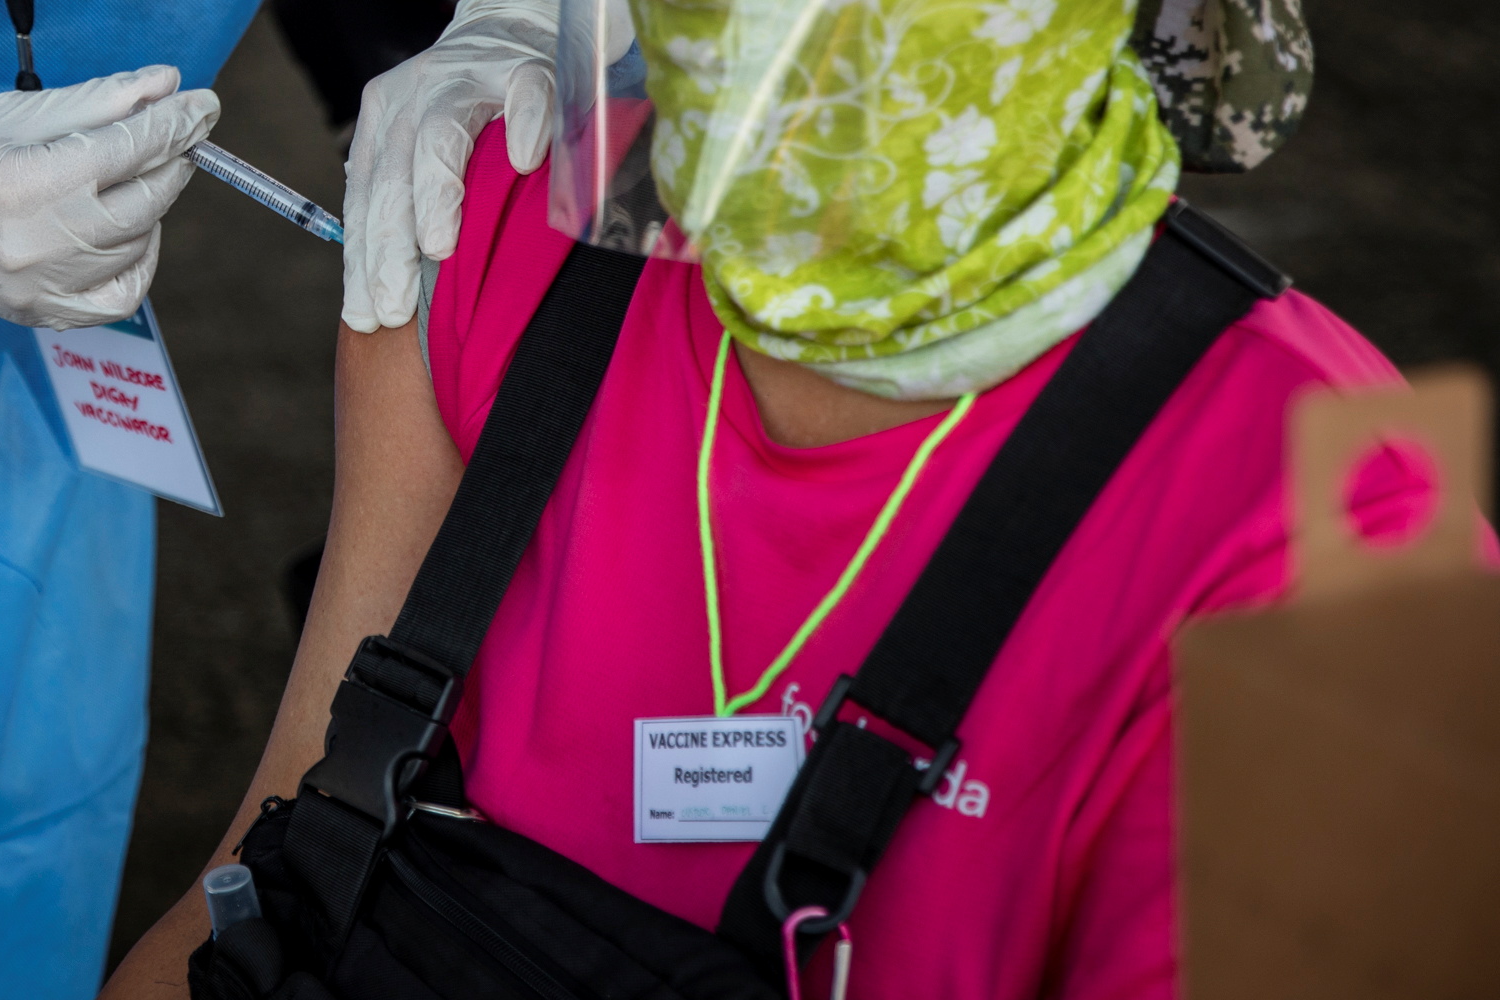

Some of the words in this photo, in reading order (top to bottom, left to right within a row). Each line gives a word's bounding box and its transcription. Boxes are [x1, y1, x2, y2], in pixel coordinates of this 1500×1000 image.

[52, 344, 96, 373] JOHN
[74, 401, 174, 445] VACCINATOR
[649, 732, 708, 750] VACCINE
[712, 730, 787, 748] EXPRESS
[674, 766, 753, 788] Registered
[649, 809, 675, 820] Name:
